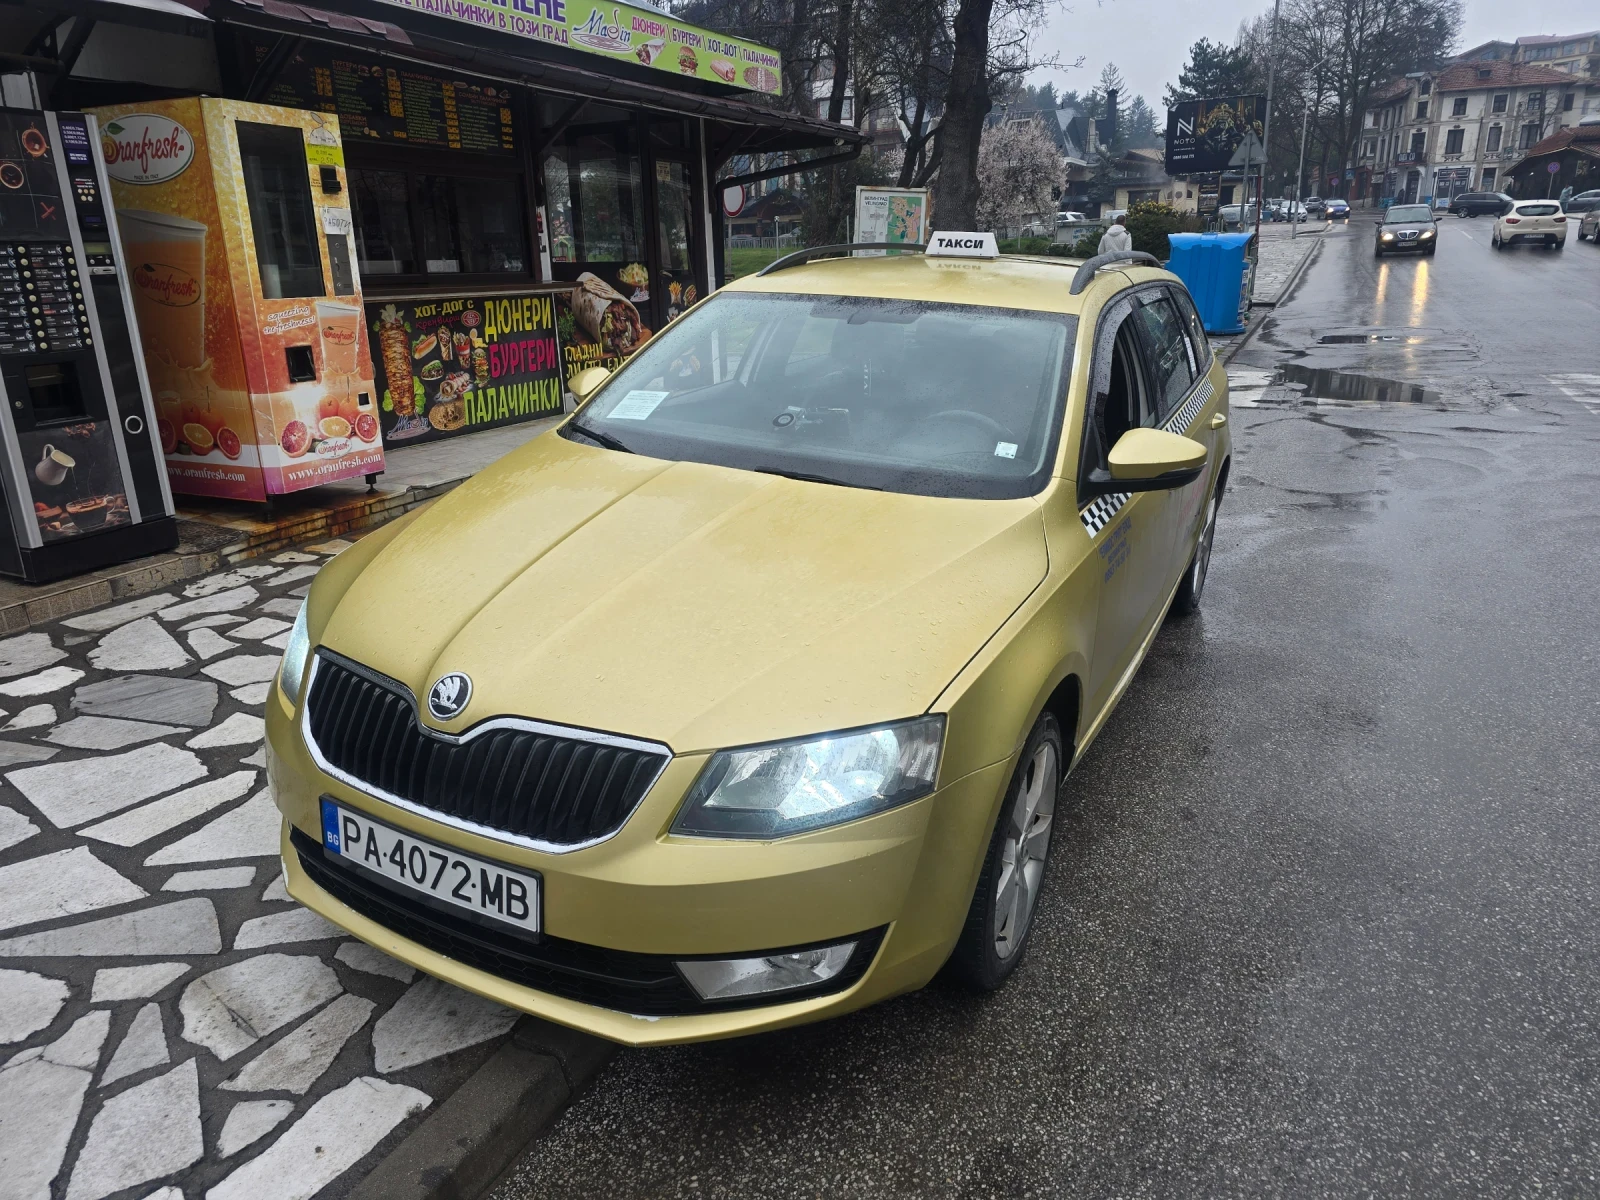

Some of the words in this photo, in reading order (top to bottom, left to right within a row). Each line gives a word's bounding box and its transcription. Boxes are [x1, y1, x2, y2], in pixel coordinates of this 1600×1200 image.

[498, 12, 507, 28] В
[509, 15, 540, 37] ТОЗИ
[542, 23, 569, 45] ГРАД
[631, 16, 665, 39] ДЮНЕРИ
[672, 27, 701, 49] БУРГЕРИ
[743, 48, 779, 69] ПАЛАЧИНКИ
[1173, 137, 1196, 145] NOTO
[937, 238, 984, 249] ТАКСИ
[268, 306, 310, 323] squeezing
[413, 299, 465, 319] ХОТ-ДОГ
[484, 296, 552, 343] ДЮНЕРИ
[489, 337, 556, 379] БУРГЕРИ
[563, 342, 604, 362] ГЛАДНИ
[464, 376, 561, 426] ПАЛАЧИНКИ
[288, 454, 382, 481] www.oranfresh.com
[326, 831, 339, 846] BG
